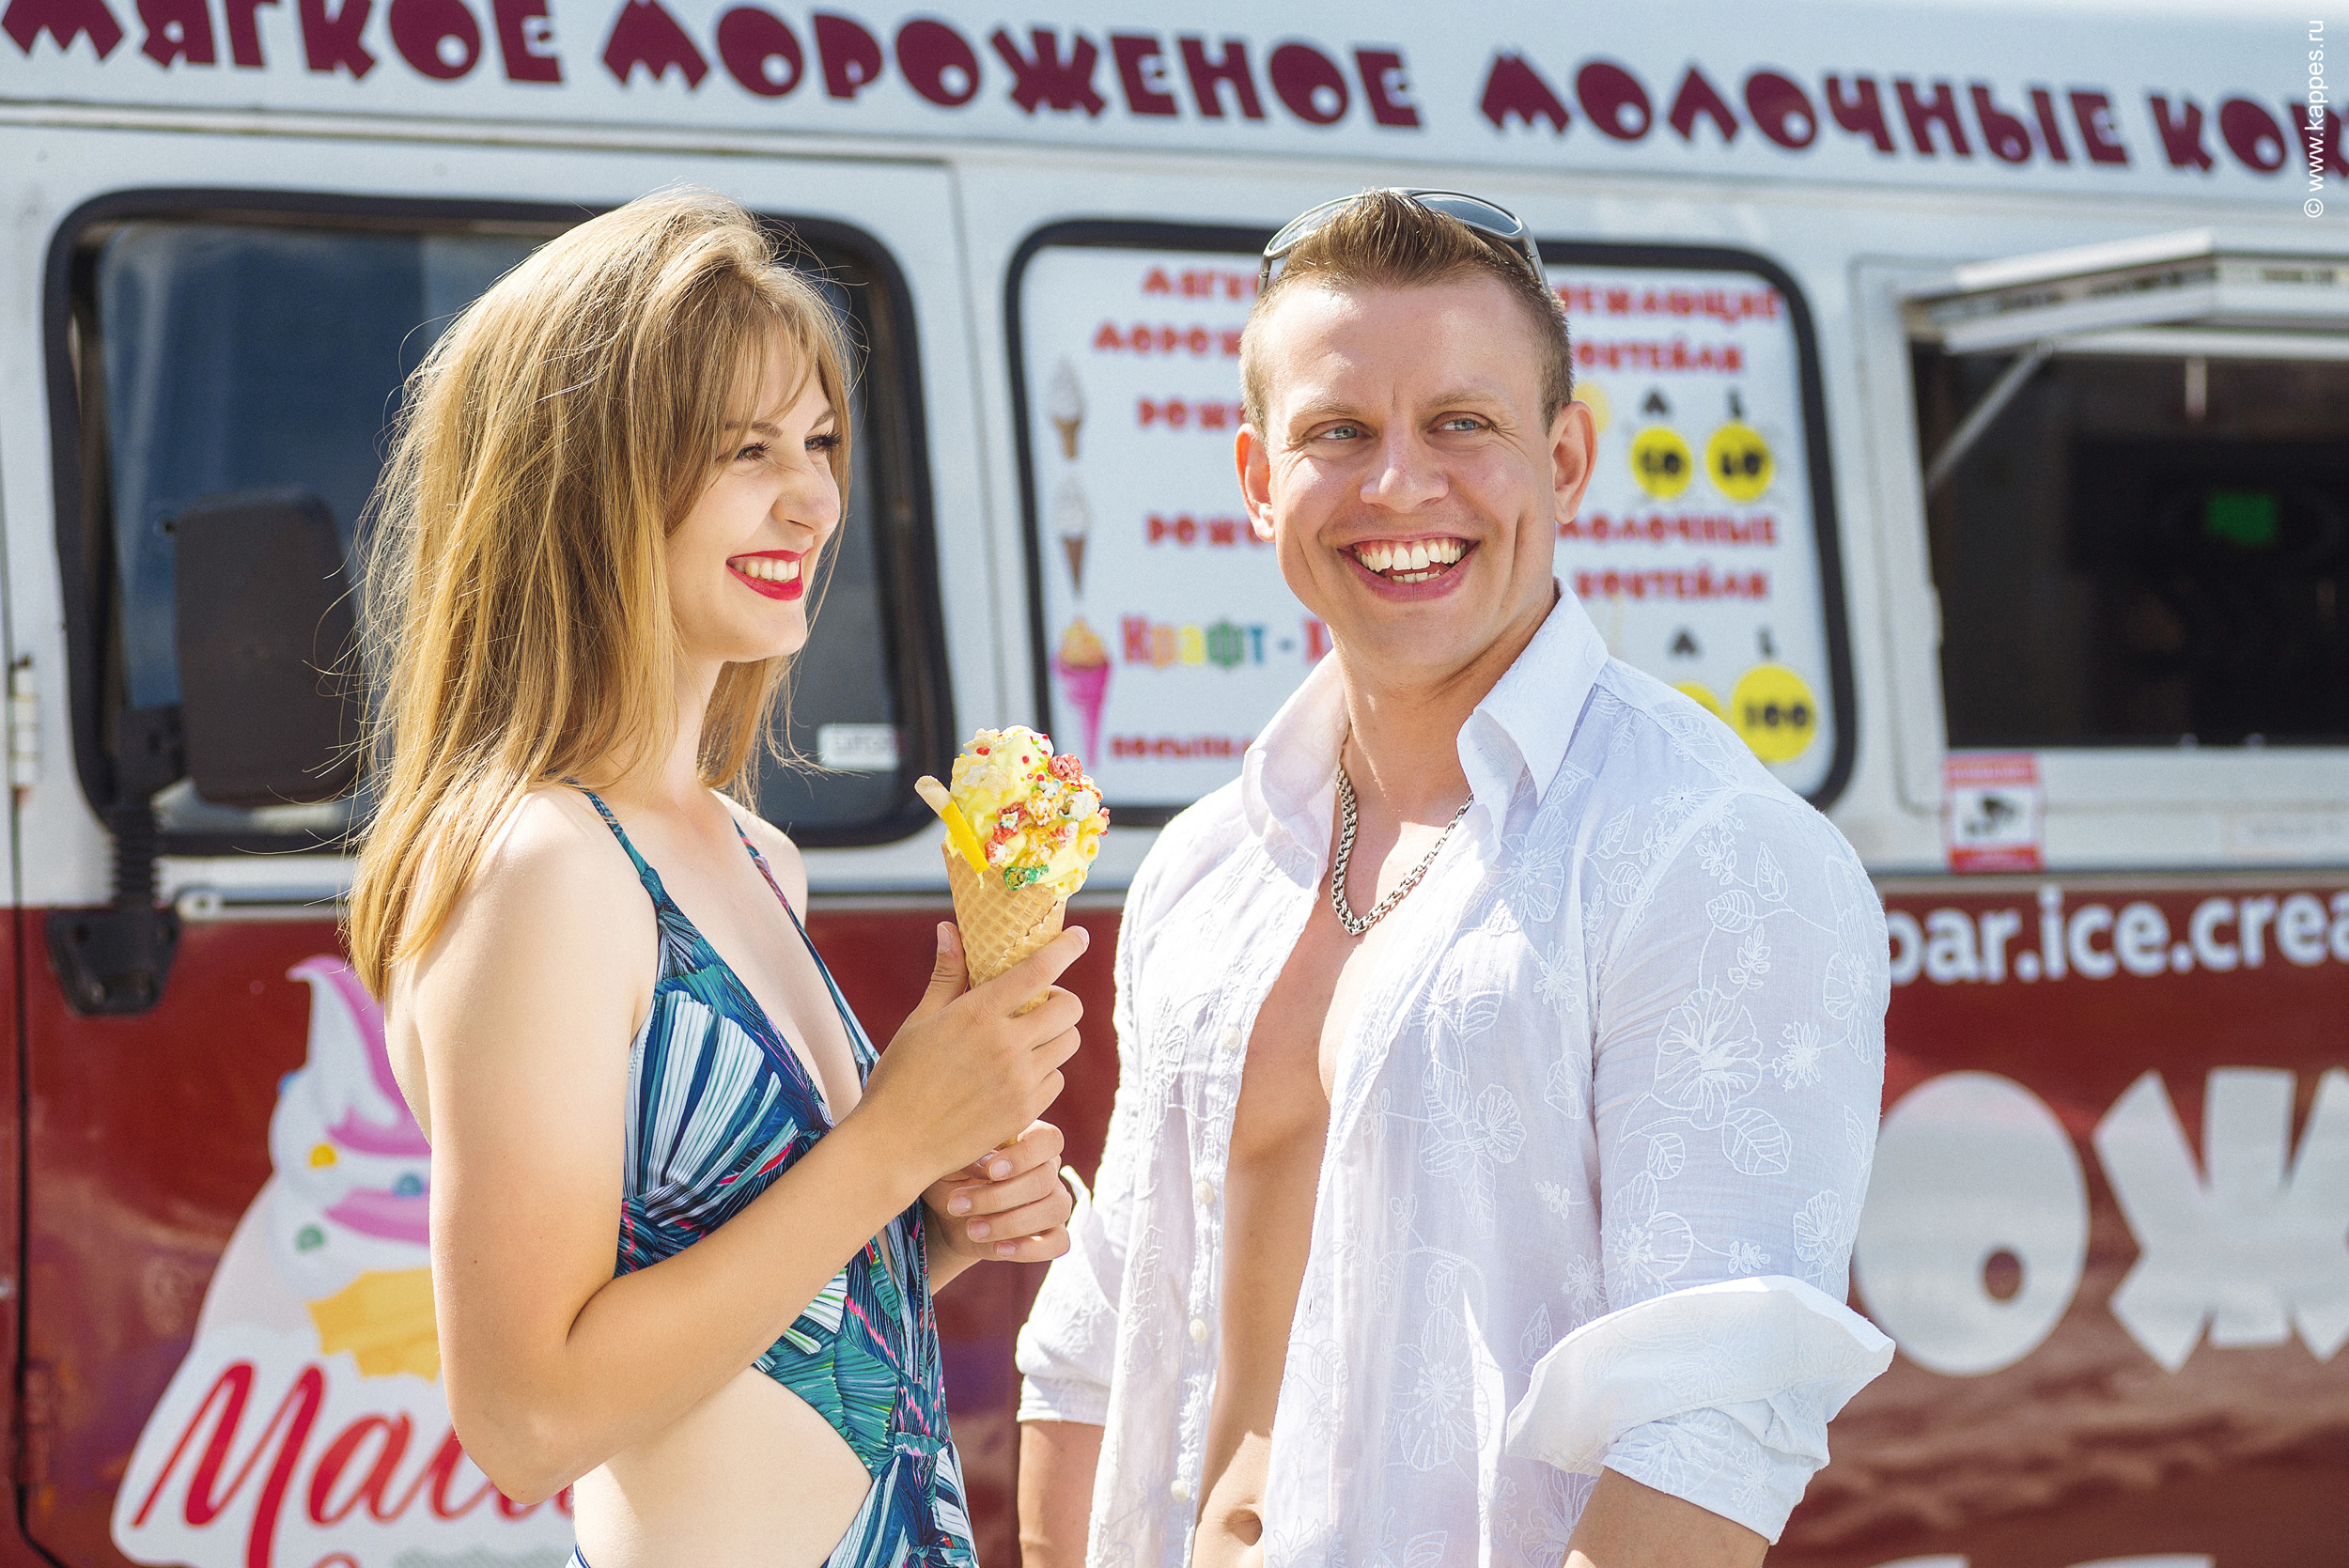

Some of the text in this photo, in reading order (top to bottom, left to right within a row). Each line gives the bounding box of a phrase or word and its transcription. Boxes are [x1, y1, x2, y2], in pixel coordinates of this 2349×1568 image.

[2, 0, 2349, 179] МЯГКОЕ МОРОЖЕНОЕ МОЛОЧНЫЕ КОК
